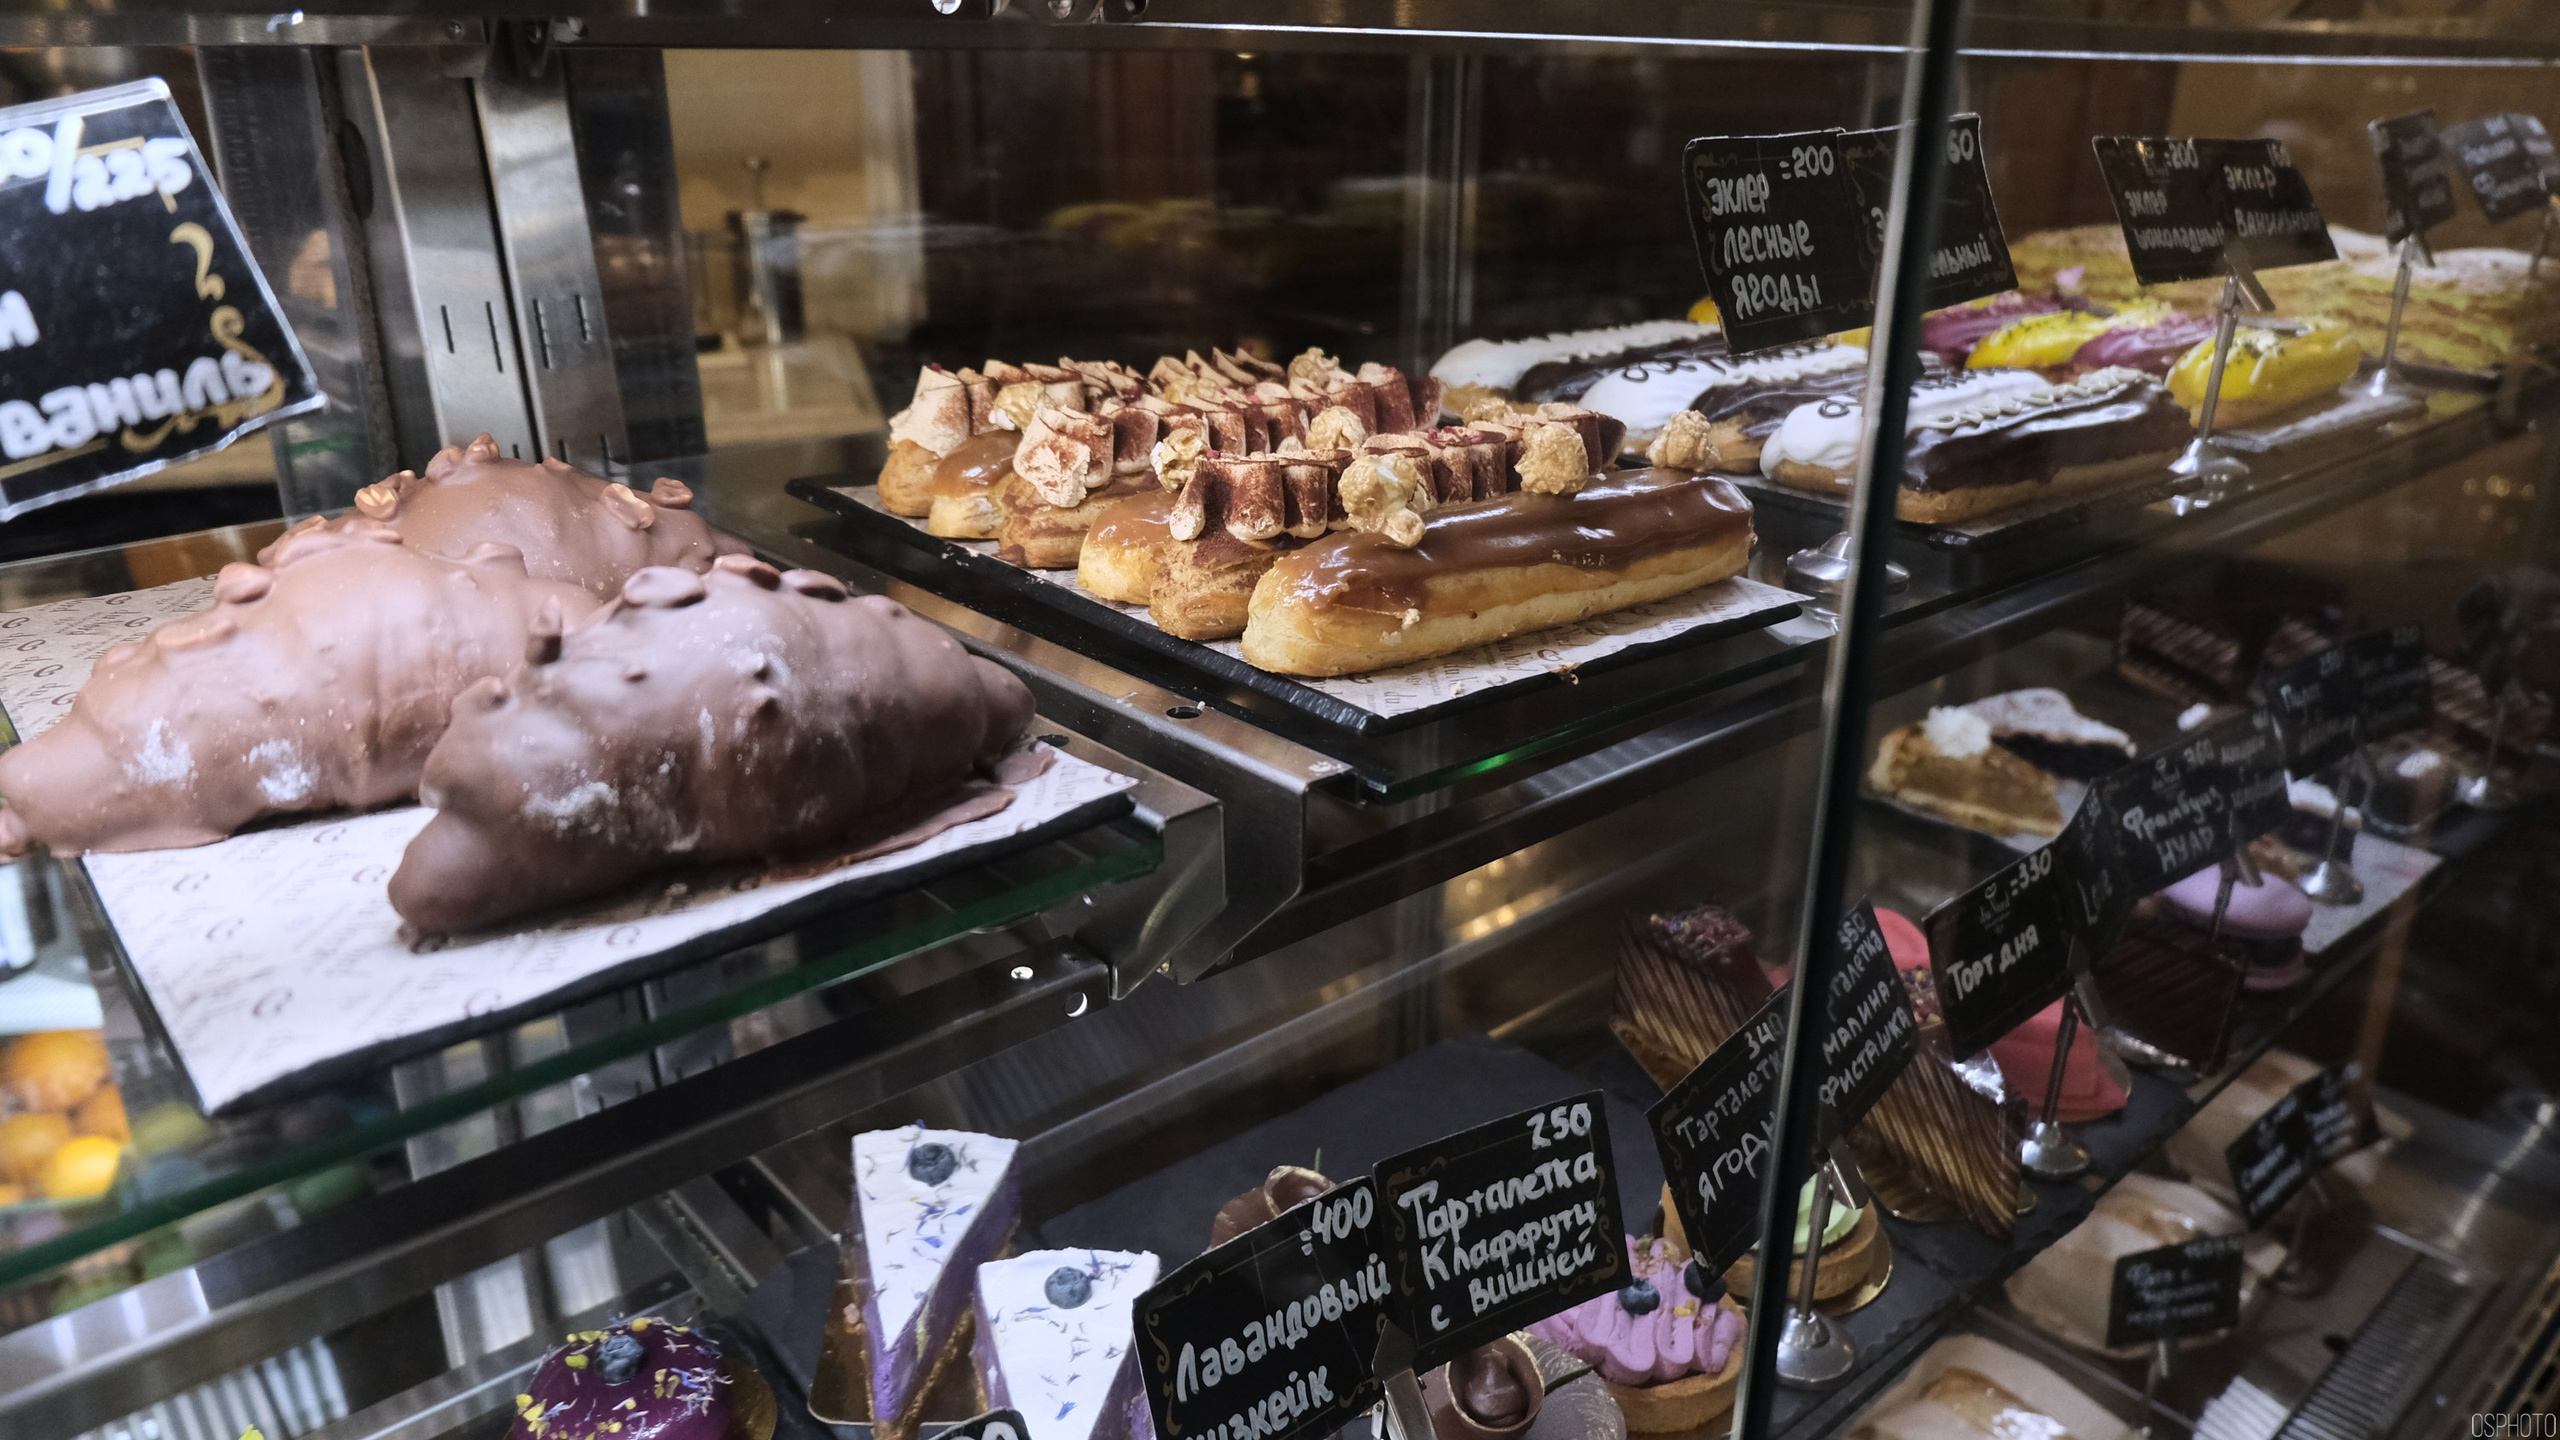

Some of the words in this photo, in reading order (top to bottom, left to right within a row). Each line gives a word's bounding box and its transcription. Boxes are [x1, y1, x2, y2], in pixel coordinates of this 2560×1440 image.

[1526, 1102, 1592, 1150] 250
[1674, 1047, 1784, 1149] Тарталетк
[1397, 1151, 1598, 1247] Тарталетка
[1176, 1252, 1392, 1403] Лавандовый
